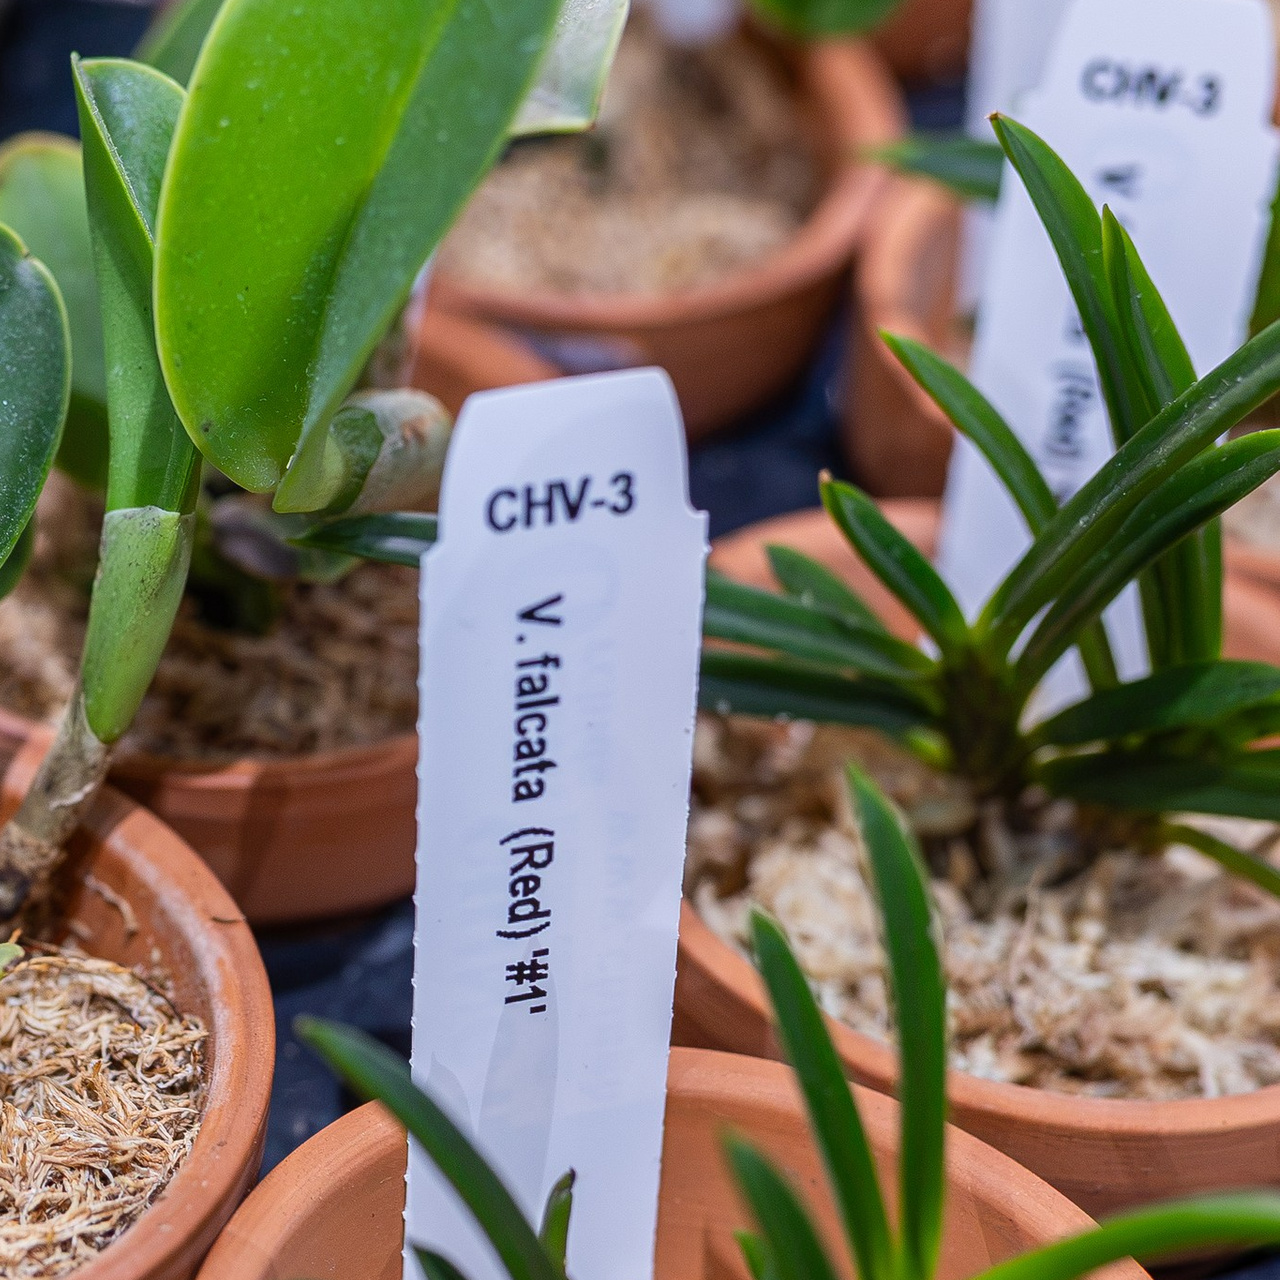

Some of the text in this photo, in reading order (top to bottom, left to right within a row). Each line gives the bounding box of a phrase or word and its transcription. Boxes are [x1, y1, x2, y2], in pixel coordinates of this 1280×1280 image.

[485, 471, 636, 533] CHV-3
[511, 651, 562, 804] falcata
[494, 826, 555, 941] (Red)
